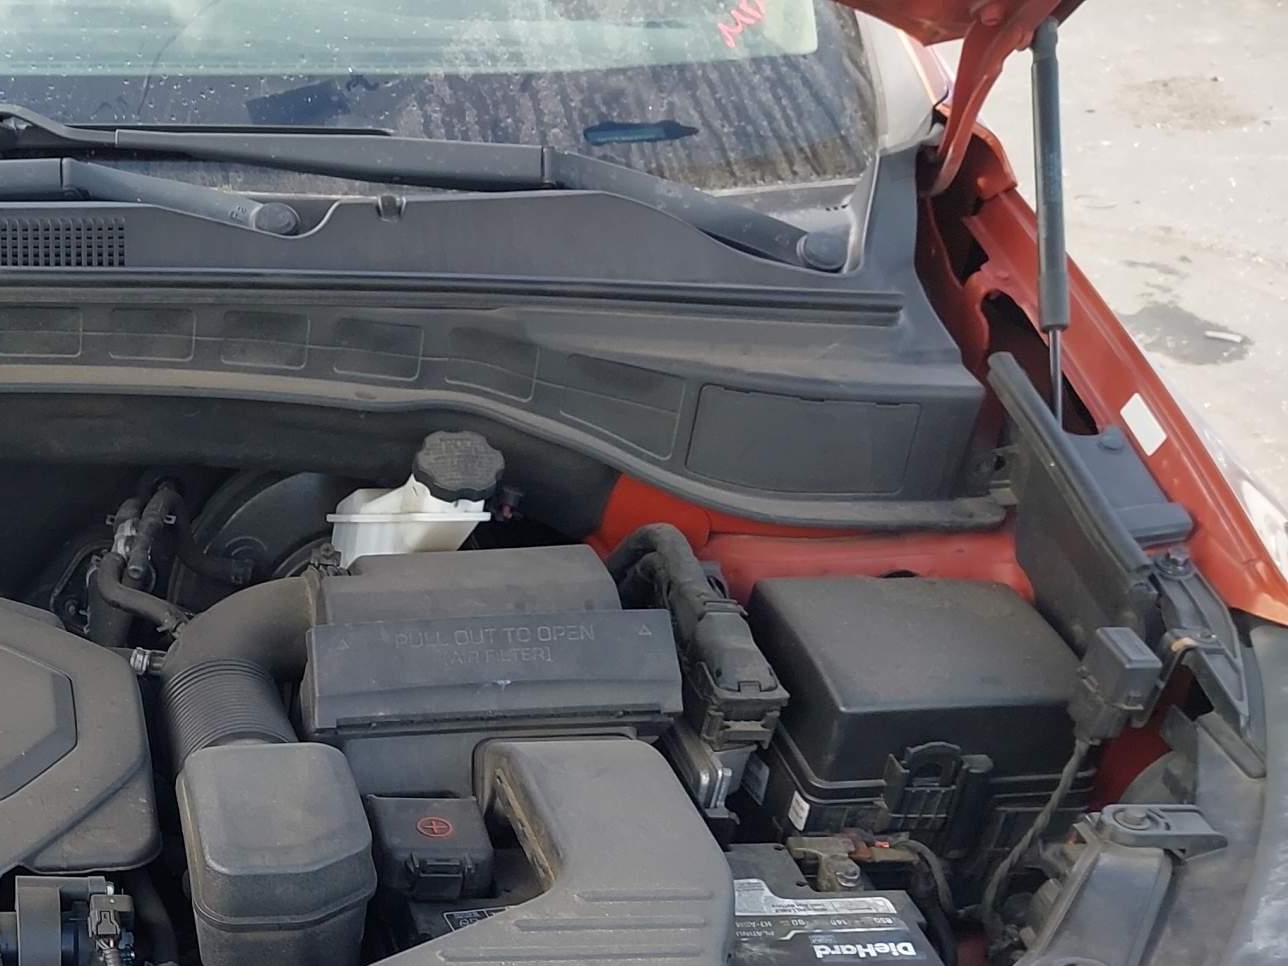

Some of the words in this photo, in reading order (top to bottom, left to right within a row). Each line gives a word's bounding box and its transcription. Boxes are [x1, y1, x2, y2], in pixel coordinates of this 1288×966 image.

[395, 630, 449, 649] PULL
[454, 628, 496, 647] OUT
[502, 627, 531, 644] TO
[536, 624, 595, 642] OPEN
[735, 930, 775, 939] PLATINU
[813, 941, 917, 959] DieHard
